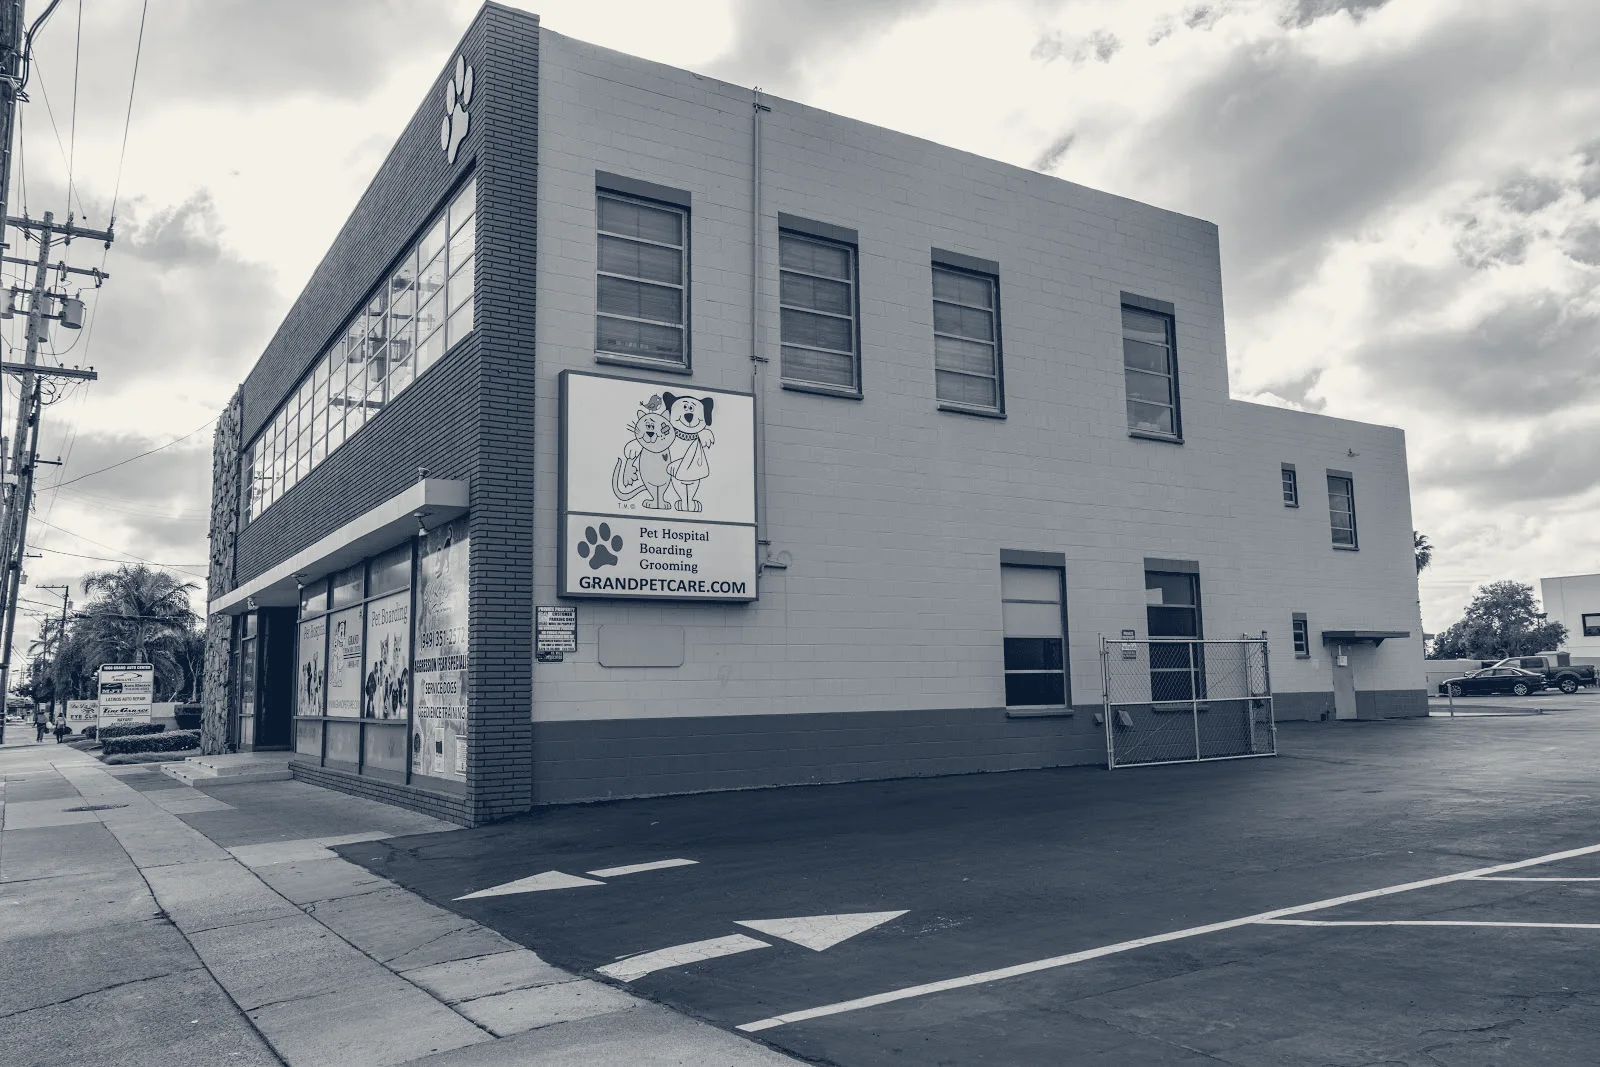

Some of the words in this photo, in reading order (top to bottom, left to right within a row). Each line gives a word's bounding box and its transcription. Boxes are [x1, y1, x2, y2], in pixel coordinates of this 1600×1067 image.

[640, 528, 658, 539] Pet
[662, 529, 709, 542] Hospital
[640, 543, 693, 558] Boarding
[639, 559, 698, 573] Grooming
[579, 576, 746, 594] GRANDPETCARE.COM
[382, 603, 408, 624] Boarding
[425, 682, 443, 695] SERVICE
[443, 681, 457, 694] DOGS
[418, 706, 442, 718] OBEDIENCE
[442, 706, 465, 719] TRAINING
